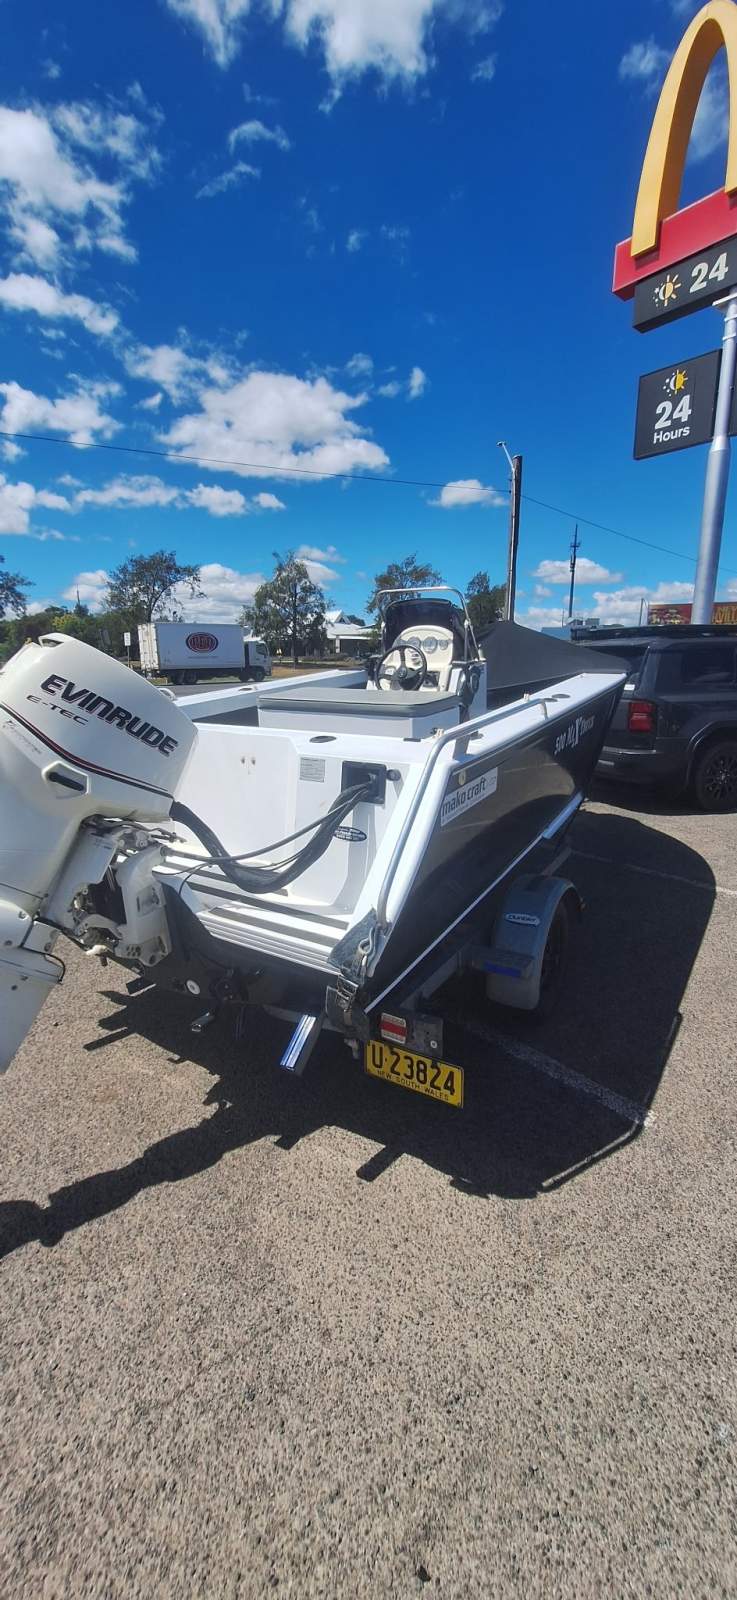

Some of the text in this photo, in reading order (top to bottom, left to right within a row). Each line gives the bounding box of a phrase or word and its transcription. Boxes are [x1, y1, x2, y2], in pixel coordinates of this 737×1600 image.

[689, 253, 728, 293] 24
[654, 394, 692, 430] 24
[653, 425, 691, 444] Hours
[26, 694, 89, 726] E-TEC
[41, 674, 179, 757] EVINRUDE
[395, 1077, 420, 1089] SOUTH
[424, 1087, 449, 1101] WALES
